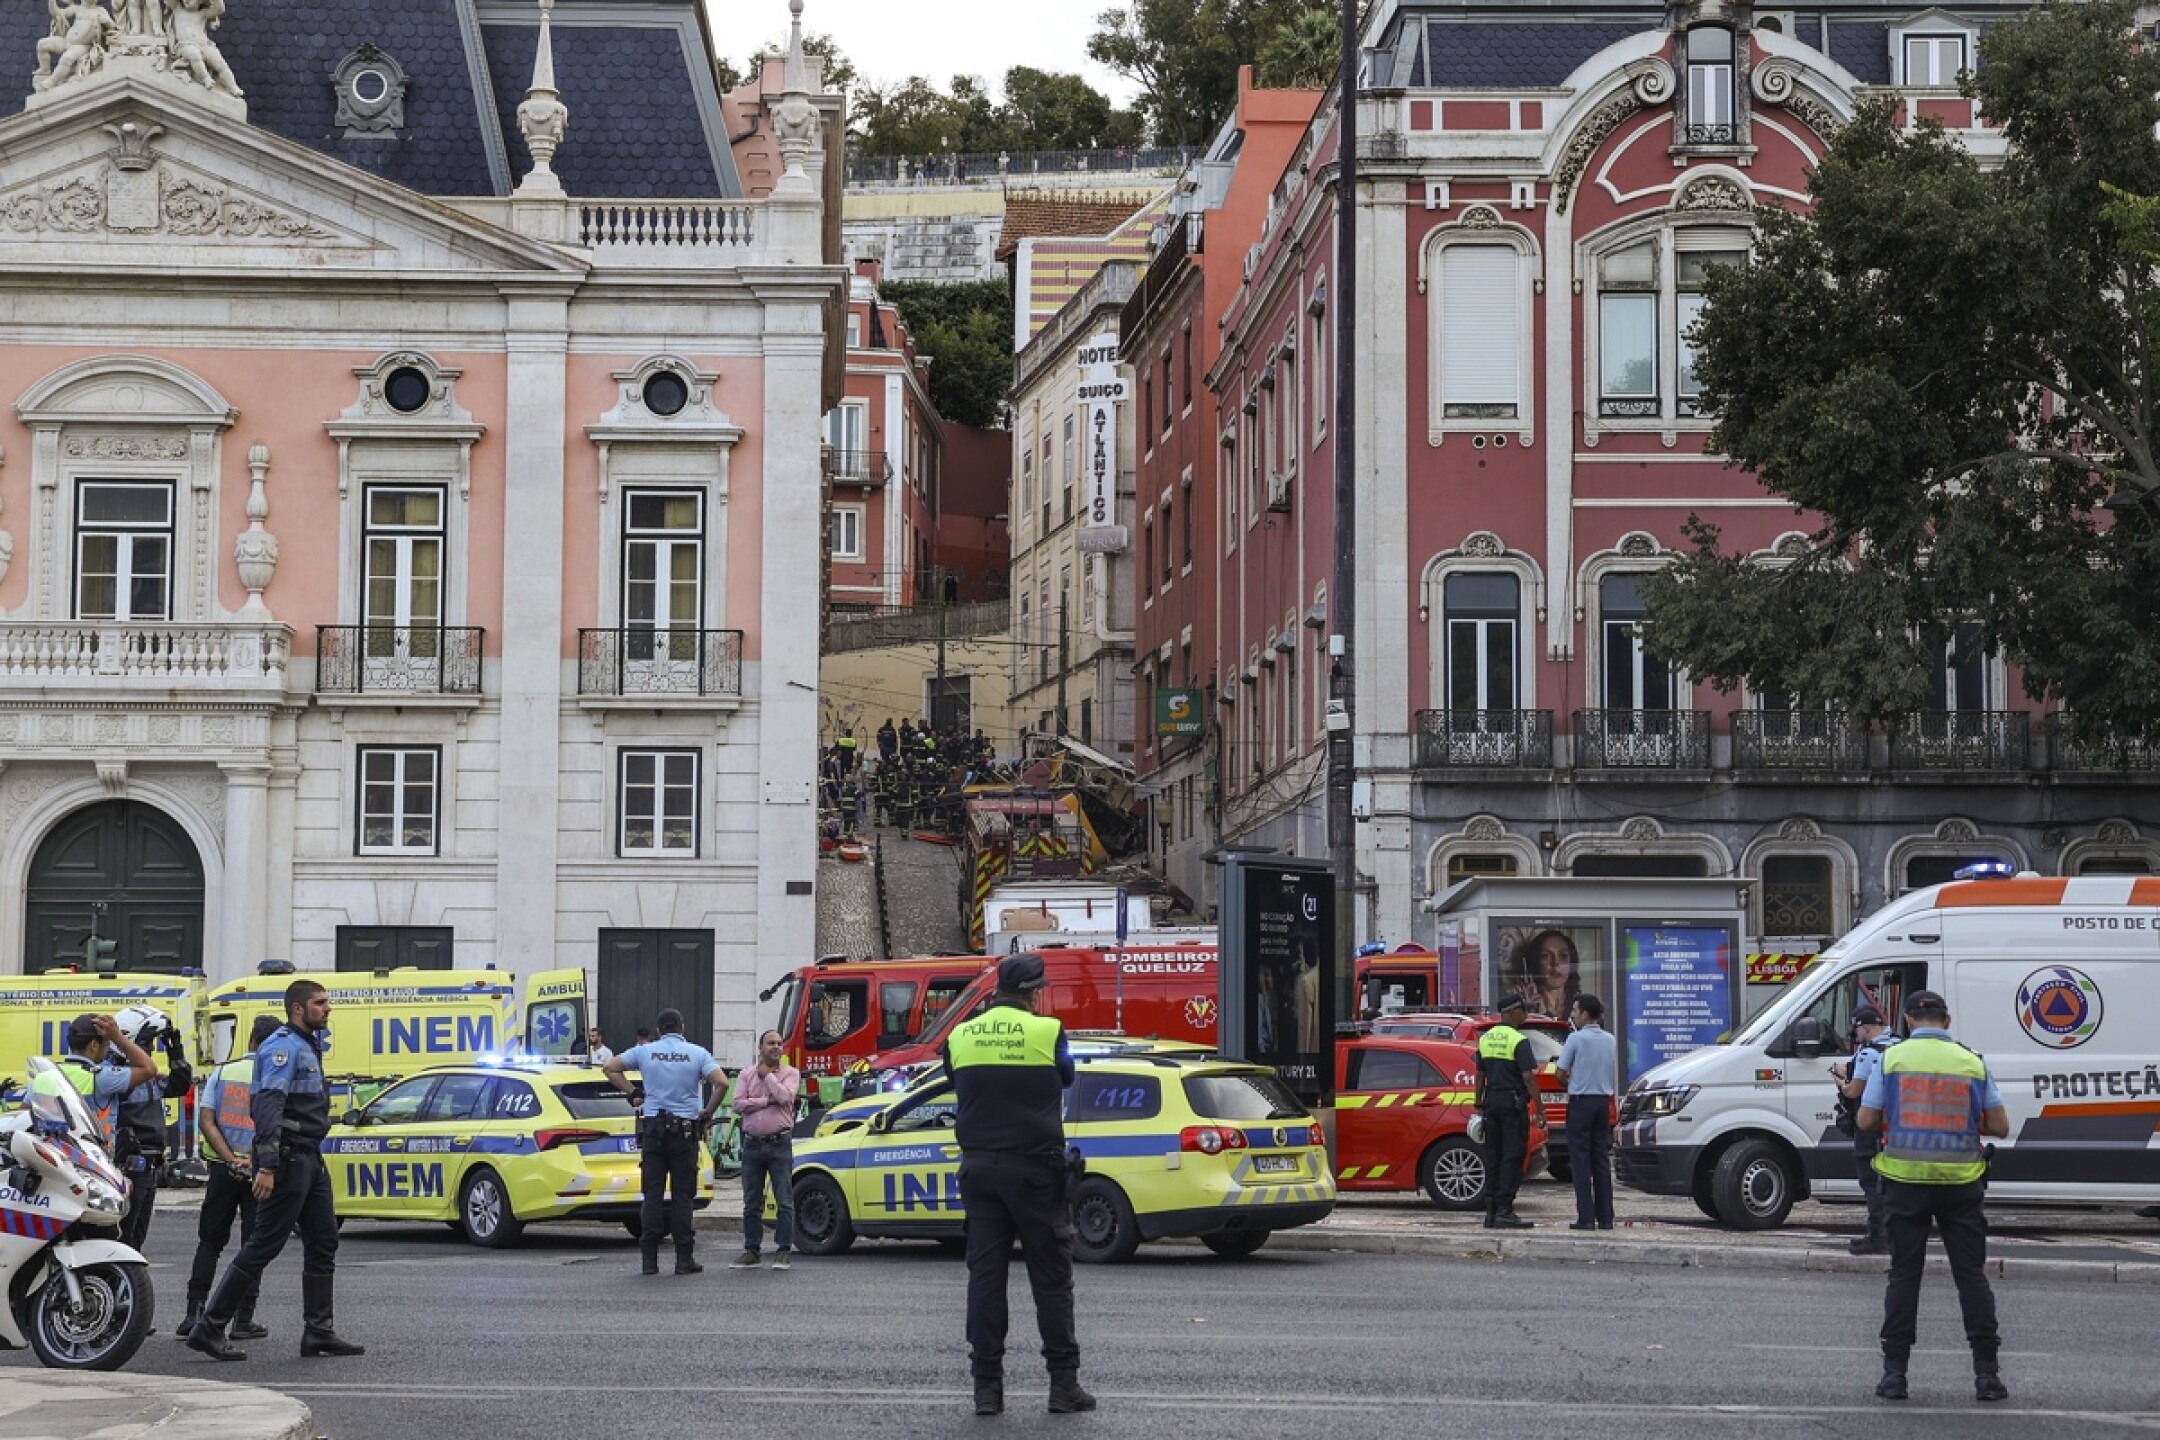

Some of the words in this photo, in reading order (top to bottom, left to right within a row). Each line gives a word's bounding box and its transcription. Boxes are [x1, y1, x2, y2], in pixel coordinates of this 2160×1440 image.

[1158, 723, 1201, 731] SUBWAY
[2063, 918, 2118, 929] POSTO
[2124, 918, 2146, 929] DE
[1122, 963, 1205, 974] QUELUZ
[1754, 964, 1798, 974] LISBOA
[372, 1015, 495, 1056] INEM
[962, 1020, 1025, 1037] POLÍCIA
[975, 1038, 1025, 1049] municipal
[1275, 1065, 1304, 1078] TURY
[2033, 1064, 2160, 1100] PROTEÇÃ
[505, 1094, 534, 1111] 112
[1107, 1088, 1146, 1108] 112
[874, 1147, 932, 1161] EMERGÊNCIA
[347, 1162, 444, 1198] INEM
[884, 1171, 965, 1212] INE
